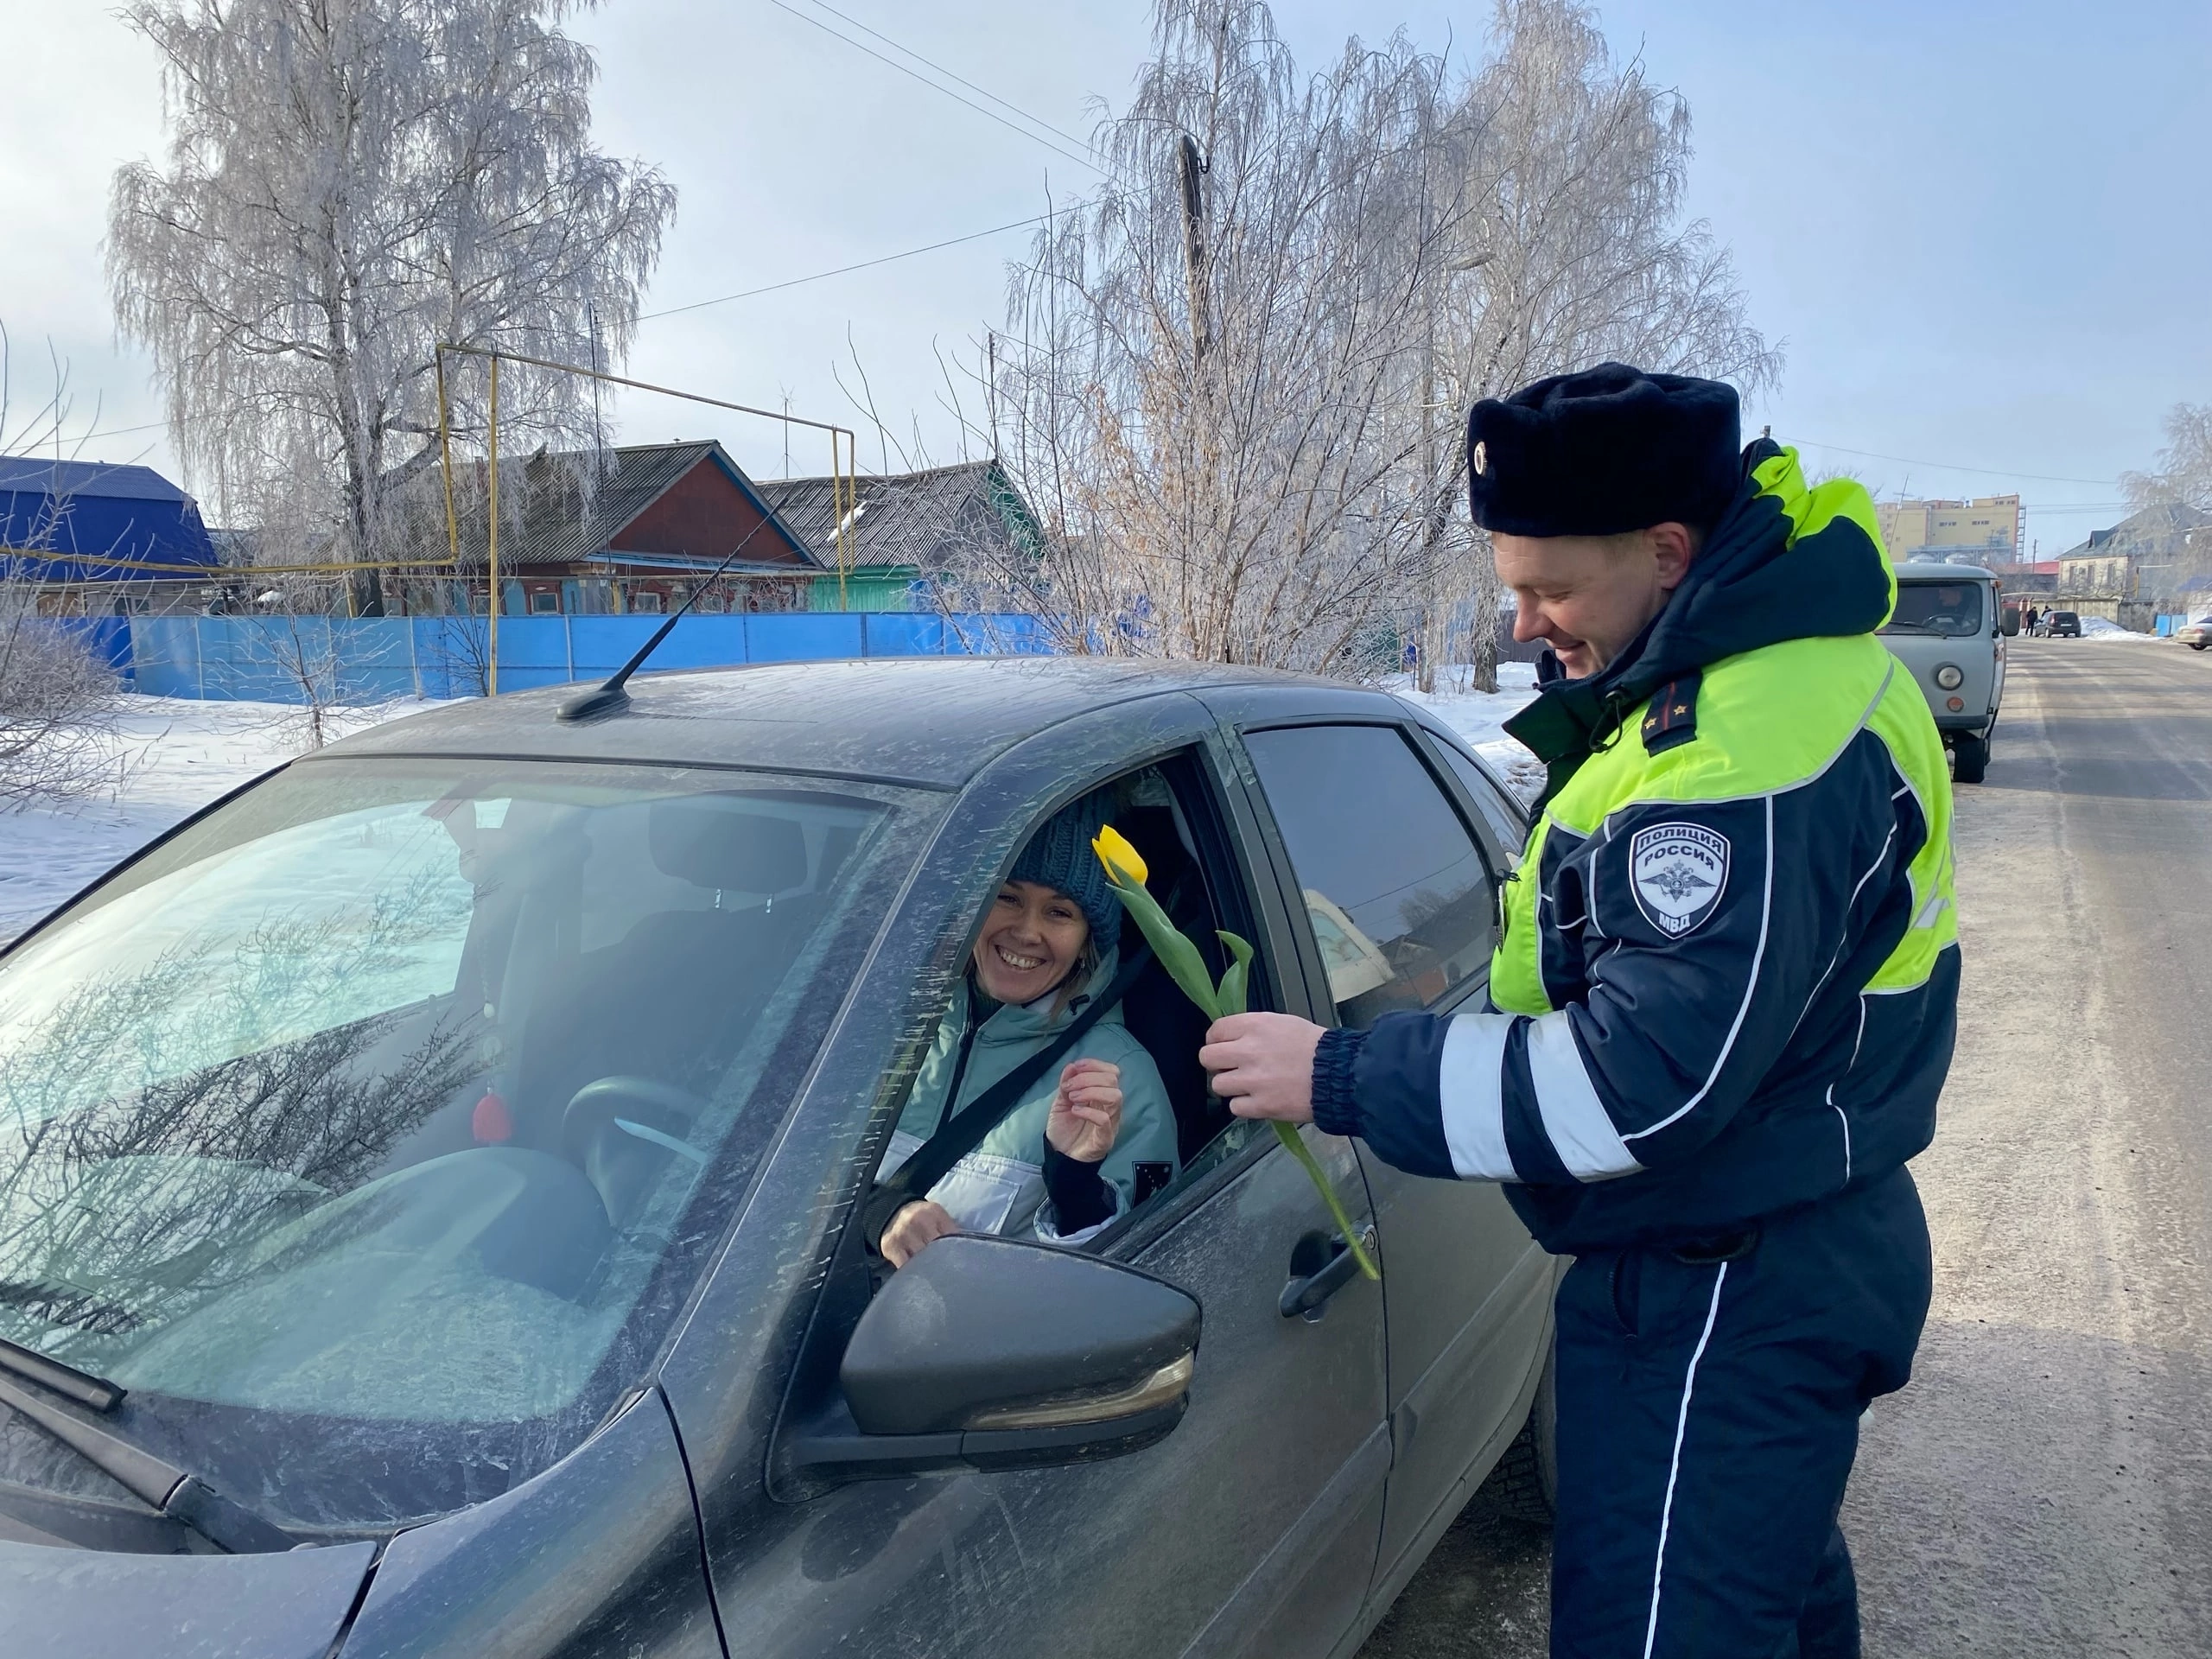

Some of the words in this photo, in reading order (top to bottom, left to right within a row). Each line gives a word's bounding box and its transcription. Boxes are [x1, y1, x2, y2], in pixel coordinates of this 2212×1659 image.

[1640, 829, 1721, 854] ПОЛИЦИЯ
[1644, 845, 1714, 871] РОССИЯ
[1659, 912, 1691, 932] МВД
